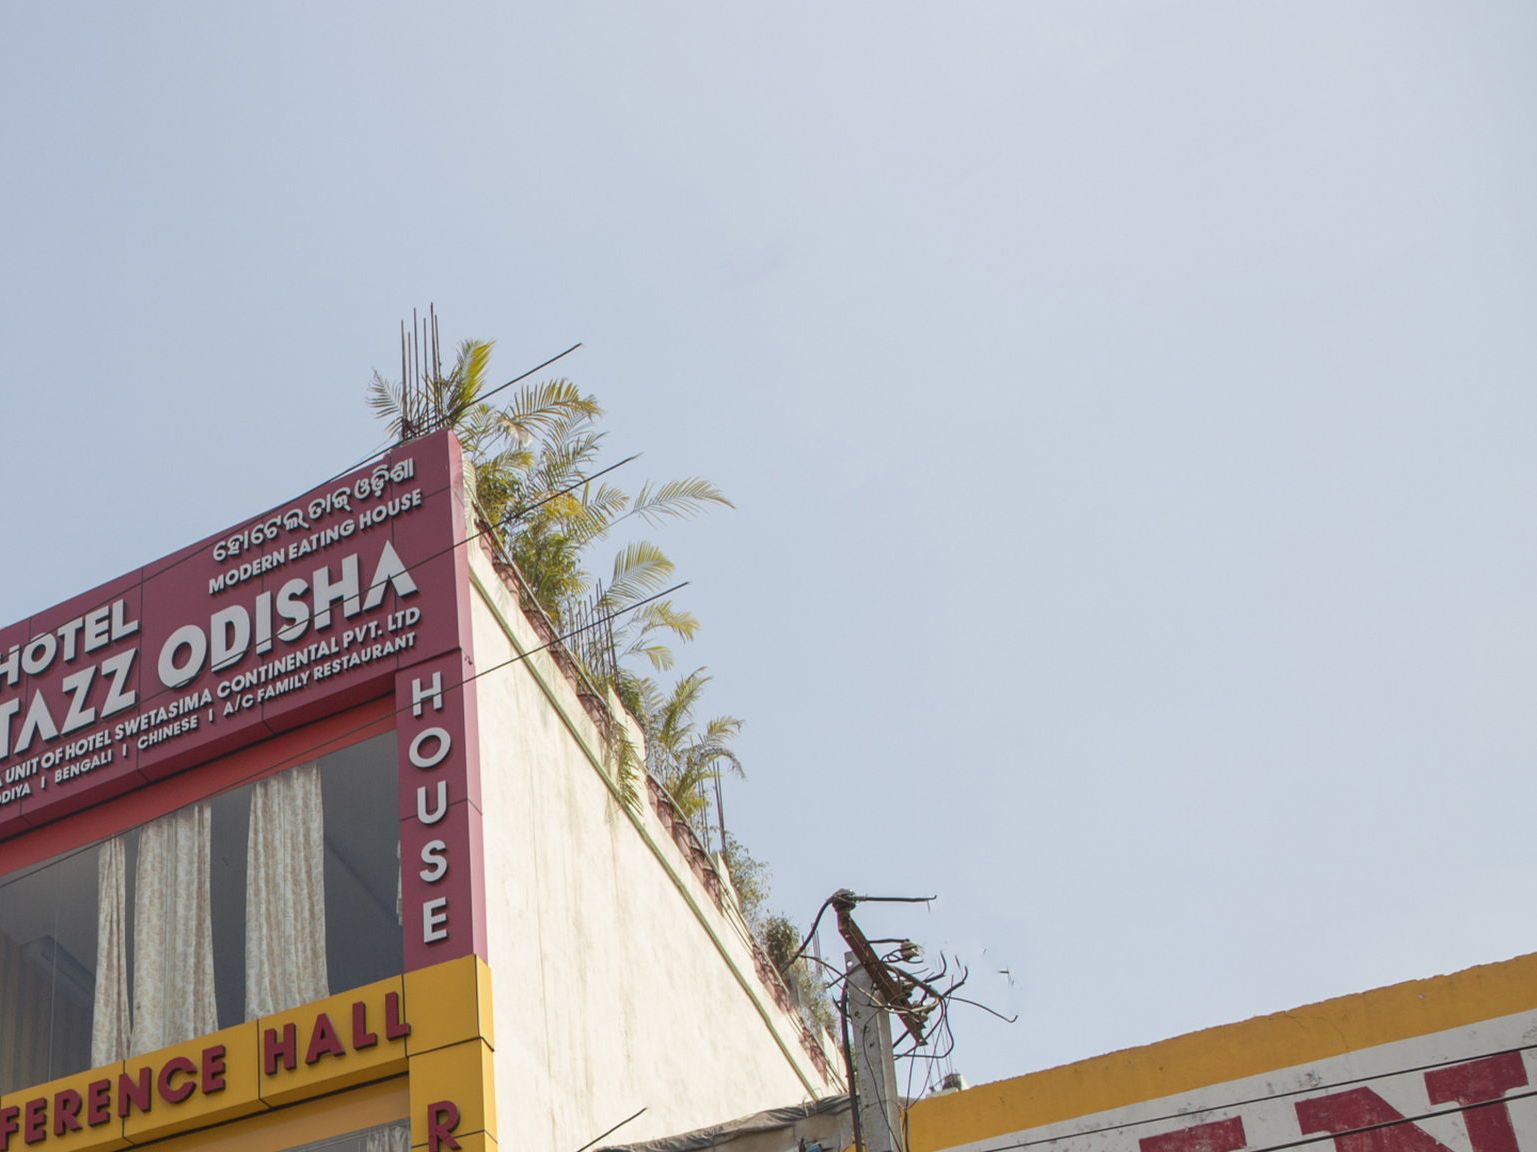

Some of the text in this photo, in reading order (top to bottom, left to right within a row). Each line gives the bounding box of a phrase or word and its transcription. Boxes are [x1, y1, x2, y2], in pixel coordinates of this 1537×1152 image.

[158, 539, 419, 689] ODISHA
[209, 488, 422, 595] MODERN EATING HOUSE
[5, 757, 40, 783] UNIT
[40, 748, 65, 770] OF
[64, 729, 112, 760] HOTEL
[114, 687, 212, 742] SWETASIMA
[217, 638, 339, 699] CONTINENTAL
[342, 620, 383, 651] PVT.
[387, 606, 421, 630] LTD
[54, 748, 113, 784] BENGALI
[137, 714, 198, 750] CHINESE
[224, 692, 255, 717] A/C
[257, 672, 310, 702] FAMILY
[313, 632, 416, 682] RESTAURANT
[408, 670, 453, 945] HOUSE
[263, 990, 411, 1077] HALL
